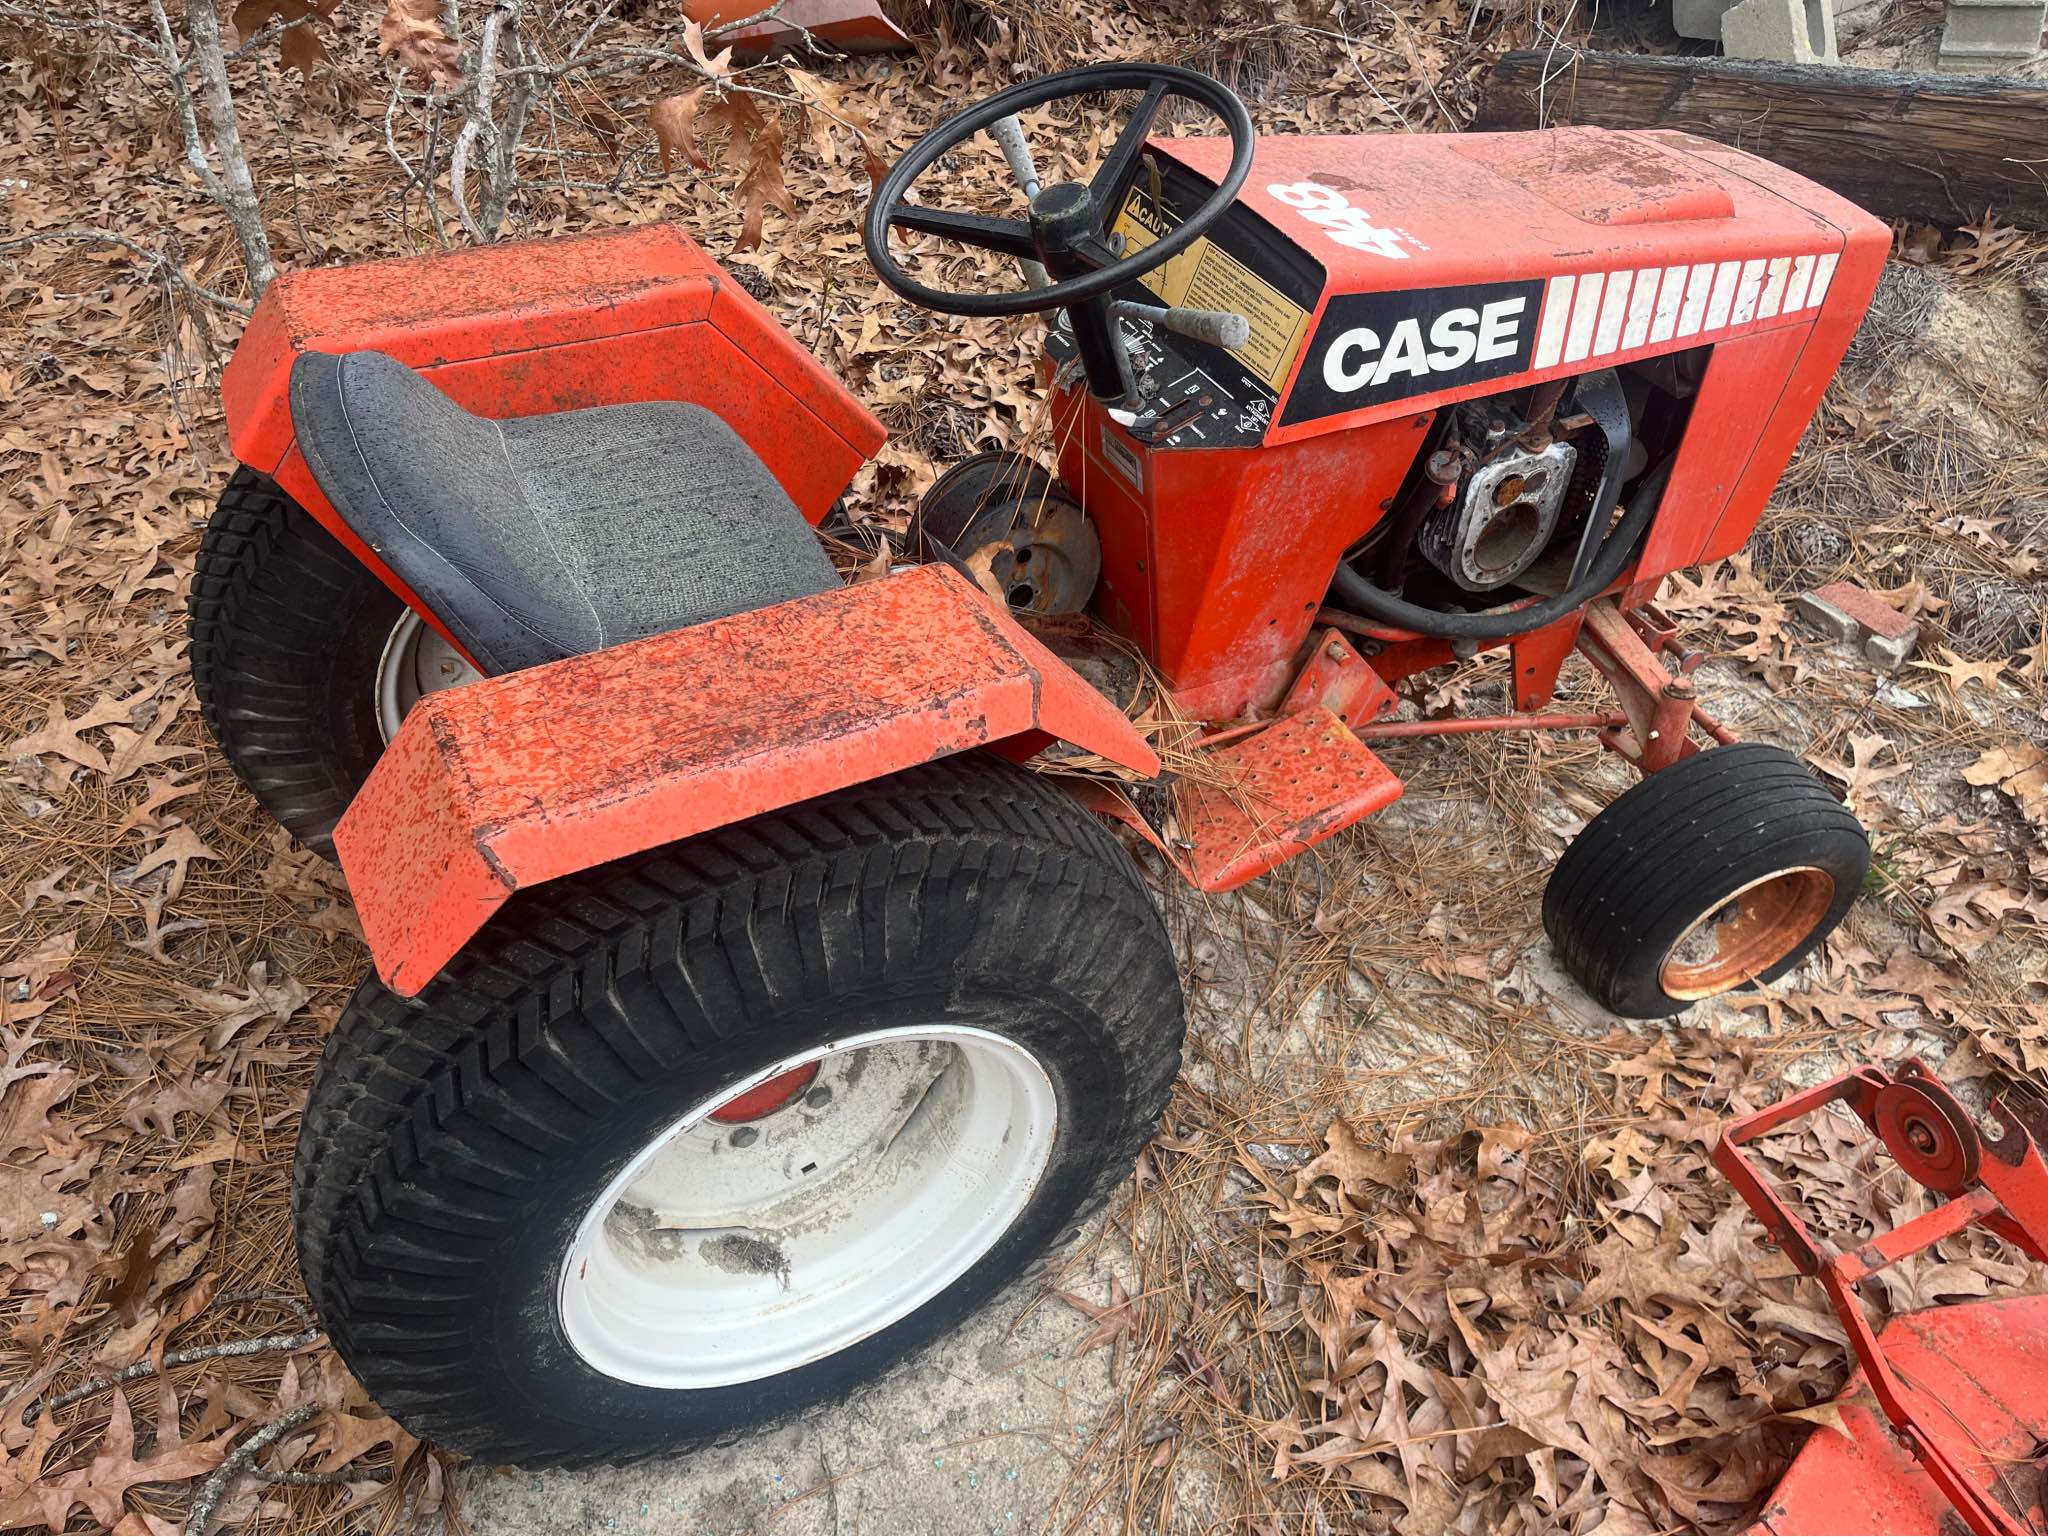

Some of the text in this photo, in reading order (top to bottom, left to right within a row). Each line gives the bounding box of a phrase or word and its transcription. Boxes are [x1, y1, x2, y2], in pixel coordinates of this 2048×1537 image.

[1138, 207, 1174, 236] CAUTI
[1265, 182, 1410, 259] 448
[1322, 296, 1527, 394] CASE
